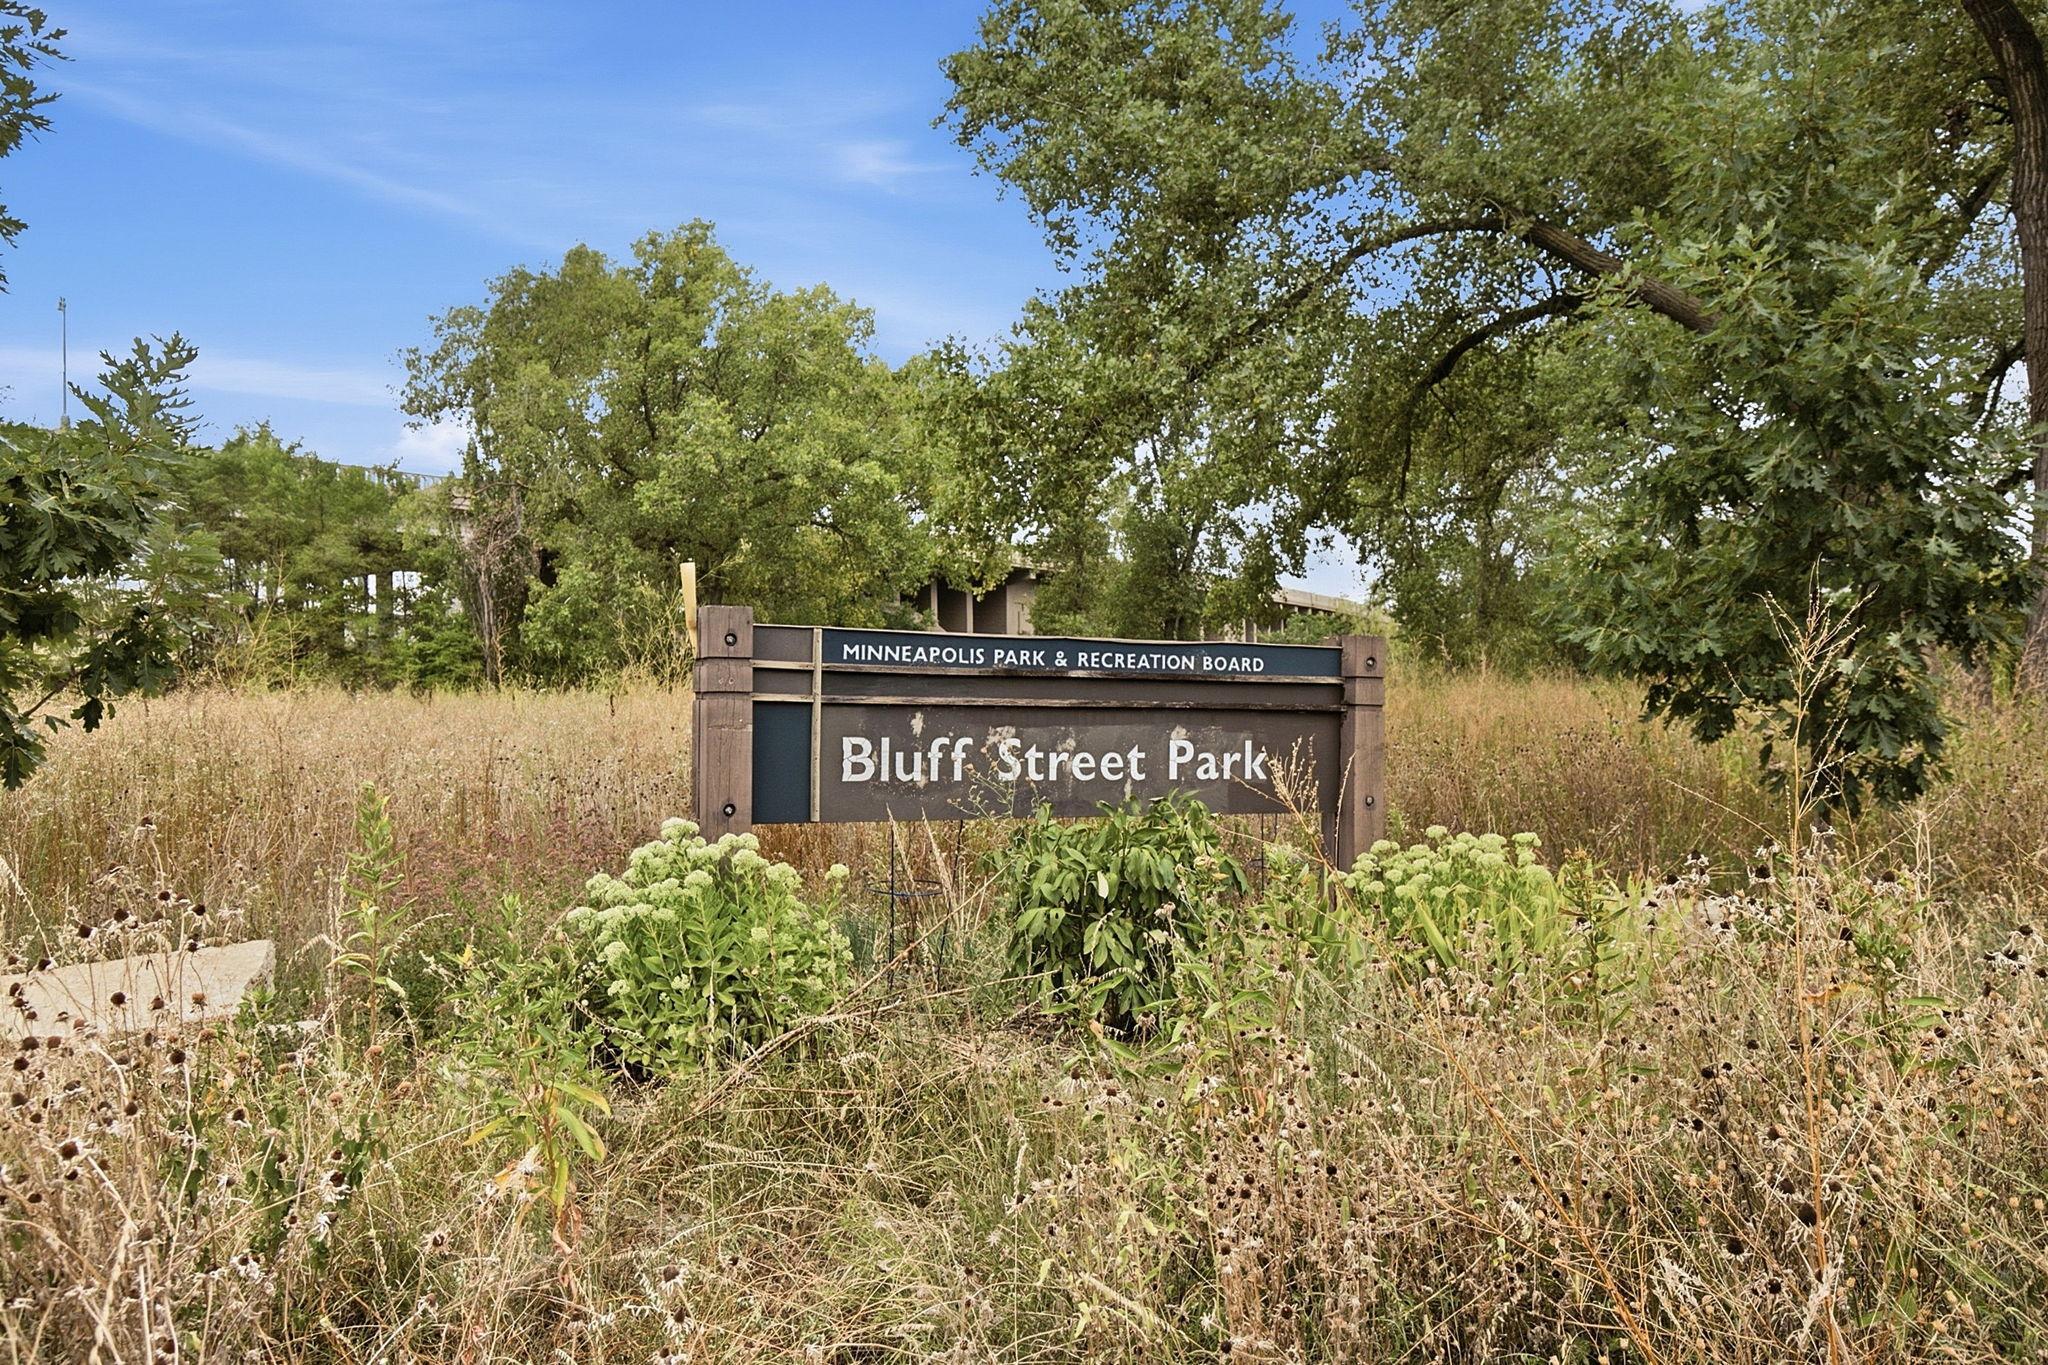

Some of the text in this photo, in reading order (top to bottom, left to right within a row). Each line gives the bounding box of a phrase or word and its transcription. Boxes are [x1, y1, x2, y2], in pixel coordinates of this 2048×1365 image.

[842, 643, 1264, 672] MINNEAPOLIS PARK & RECREATION BOARD
[841, 736, 1267, 783] Bluff Street Park
